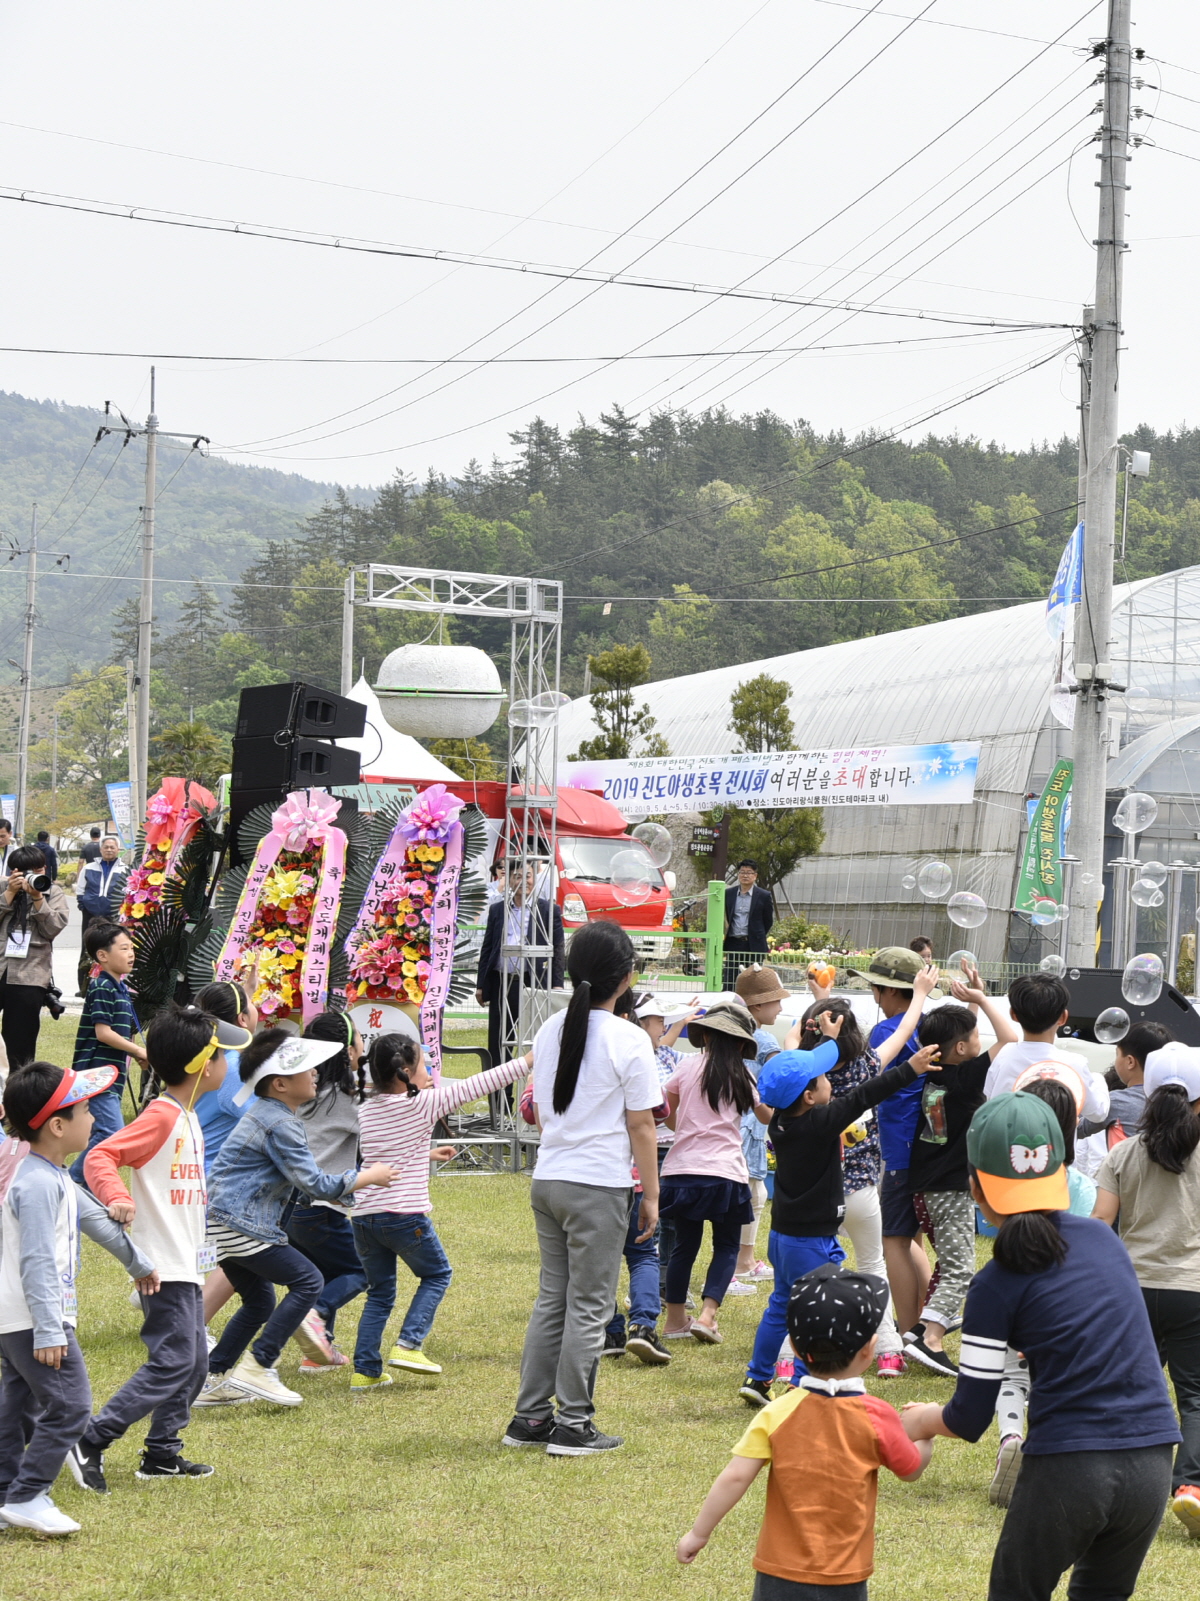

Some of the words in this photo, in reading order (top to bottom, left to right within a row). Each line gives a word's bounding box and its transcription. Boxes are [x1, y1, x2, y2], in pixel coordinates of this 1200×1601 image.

[657, 757, 695, 771] 대한민국
[698, 756, 729, 770] 진도개
[731, 754, 783, 766] 페스티벌과
[786, 751, 829, 765] 함께하는
[832, 750, 854, 764] 힐링
[857, 749, 887, 762] 체험!
[603, 777, 639, 801] 2019
[641, 771, 722, 801] 진도야생초목
[725, 768, 770, 796] 전시회
[770, 767, 831, 792] 여러분을
[832, 765, 916, 790] 초대합니다.
[753, 797, 770, 807] 장소:
[878, 793, 890, 804] 내)
[327, 866, 341, 881] 축
[305, 896, 334, 1004] 진도개페스티벌
[433, 924, 451, 973] 대한민국
[367, 1007, 383, 1029] 祝
